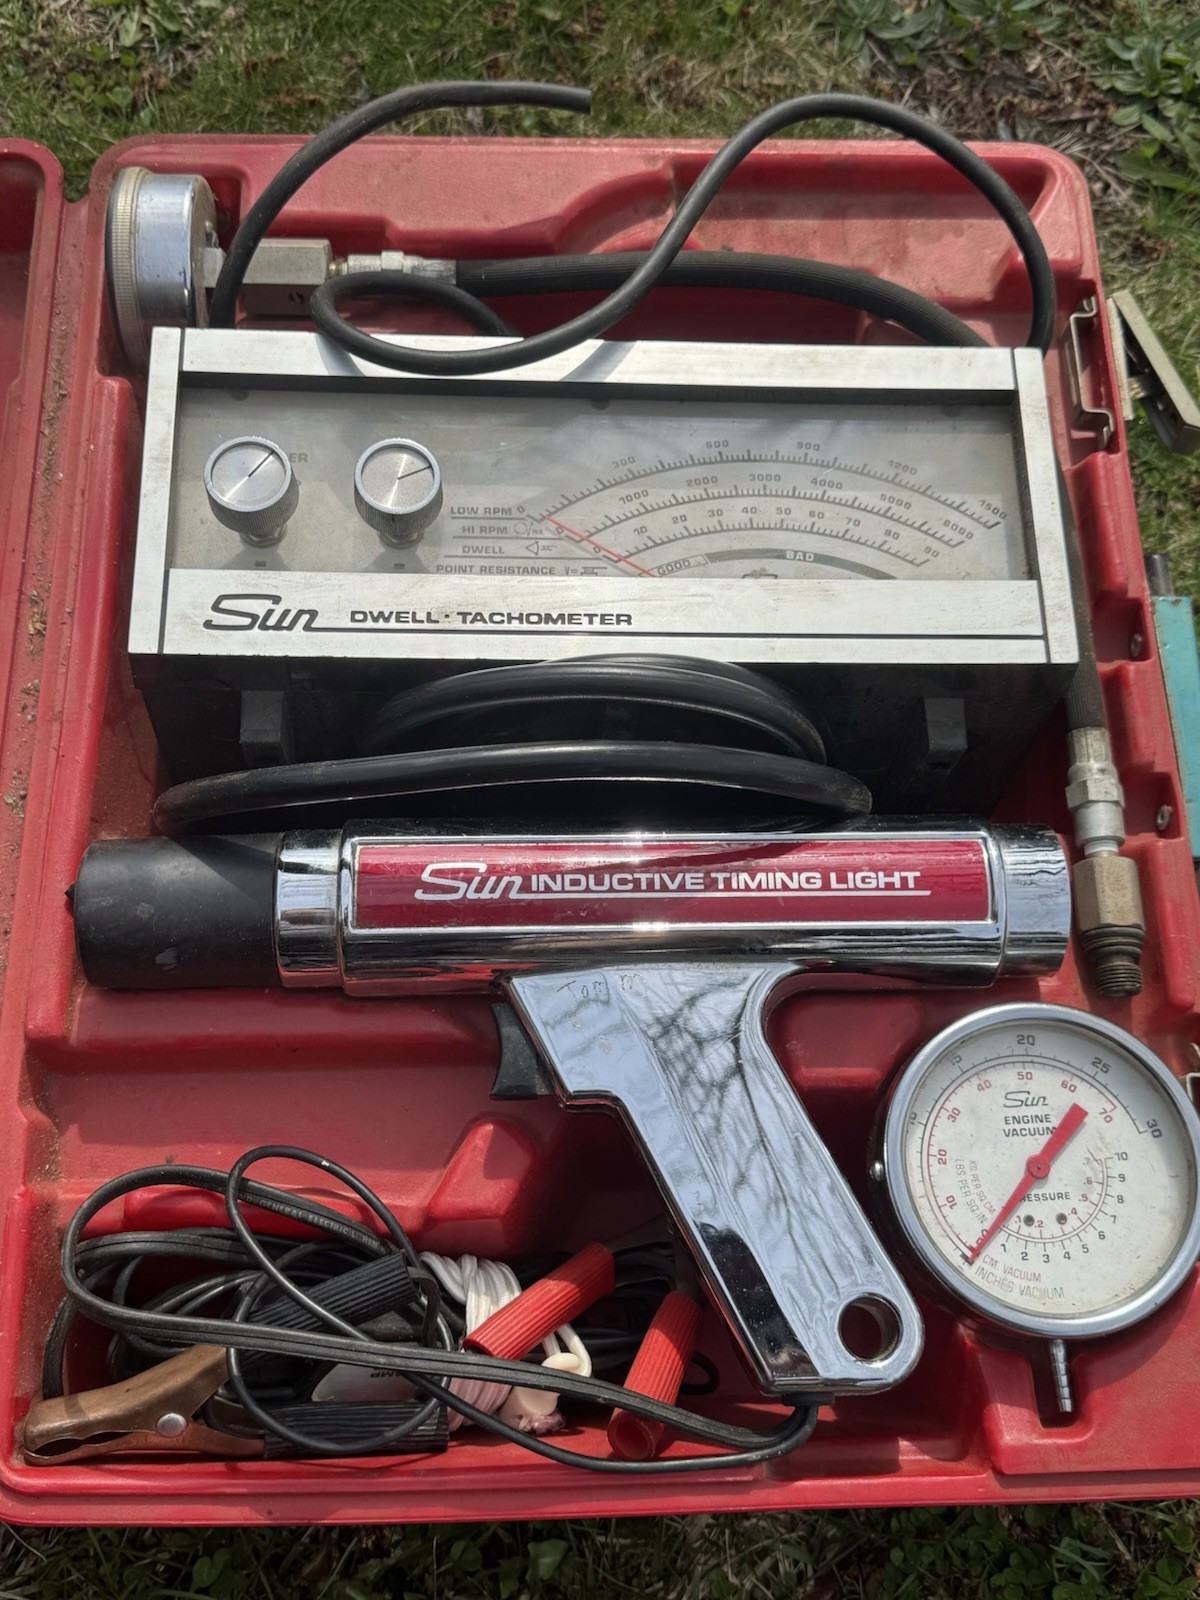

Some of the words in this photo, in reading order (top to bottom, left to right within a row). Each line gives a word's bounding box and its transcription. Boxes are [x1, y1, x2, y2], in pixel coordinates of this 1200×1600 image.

[796, 441, 820, 451] 900
[612, 456, 636, 468] 300
[887, 460, 917, 475] 1200
[686, 475, 718, 487] 2000
[748, 473, 781, 482] 3000
[810, 477, 843, 490] 4000
[619, 489, 649, 504] 1000
[880, 493, 912, 510] 5000
[450, 507, 479, 515] LOW
[483, 507, 513, 516] RPM
[707, 508, 724, 518] 30
[741, 506, 758, 515] 40
[775, 507, 792, 516] 50
[808, 510, 825, 520] 60
[979, 499, 1008, 520] 1500
[671, 514, 687, 525] 20
[846, 517, 861, 528] 70
[462, 525, 475, 534] HI
[480, 525, 508, 535] RPM
[633, 525, 649, 536] 10
[883, 528, 901, 541] 80
[942, 519, 975, 540] 6000
[462, 545, 506, 555] DWELL
[923, 546, 940, 558] 90
[785, 550, 815, 562] BAD
[436, 564, 475, 574] POINT
[480, 565, 556, 575] RESISTANCE
[656, 559, 692, 577] GOOD
[204, 593, 319, 632] Sun
[350, 610, 440, 624] DWELL
[456, 611, 633, 626] TACHOMETER
[413, 861, 522, 901] Sun
[530, 870, 704, 892] INDUCTIVE
[710, 870, 823, 891] TIMING
[830, 870, 922, 890] LIGHT
[1016, 1034, 1036, 1046] 20
[1091, 1056, 1112, 1074] 25
[1017, 1071, 1033, 1081] 50
[976, 1079, 992, 1093] 40
[1060, 1079, 1077, 1093] 60
[1003, 1090, 1049, 1108] Sun
[947, 1107, 962, 1123] 30
[1004, 1113, 1052, 1125] ENGINE
[1099, 1107, 1113, 1124] 70
[1146, 1118, 1163, 1139] 30
[937, 1148, 948, 1166] 20
[1114, 1151, 1129, 1161] 10
[1083, 1177, 1093, 1186] .6
[1118, 1173, 1126, 1183] 9
[945, 1195, 958, 1210] 10
[1079, 1194, 1088, 1202] .5
[1117, 1195, 1124, 1204] 8
[260, 1200, 303, 1218] GENERAL
[308, 1214, 350, 1235] ELECTRIC
[1068, 1207, 1078, 1217] .4
[1035, 1220, 1045, 1229] .2
[1110, 1214, 1118, 1224] 7
[1098, 1231, 1106, 1240] 6
[1001, 1243, 1007, 1253] 1
[1081, 1244, 1090, 1254] 5
[1020, 1252, 1029, 1261] 2
[1042, 1254, 1050, 1263] 3
[1063, 1251, 1072, 1261] 4
[1002, 1264, 1042, 1283] VACUUM
[975, 1265, 1014, 1293] INCHES
[1019, 1283, 1065, 1300] VACUUM
